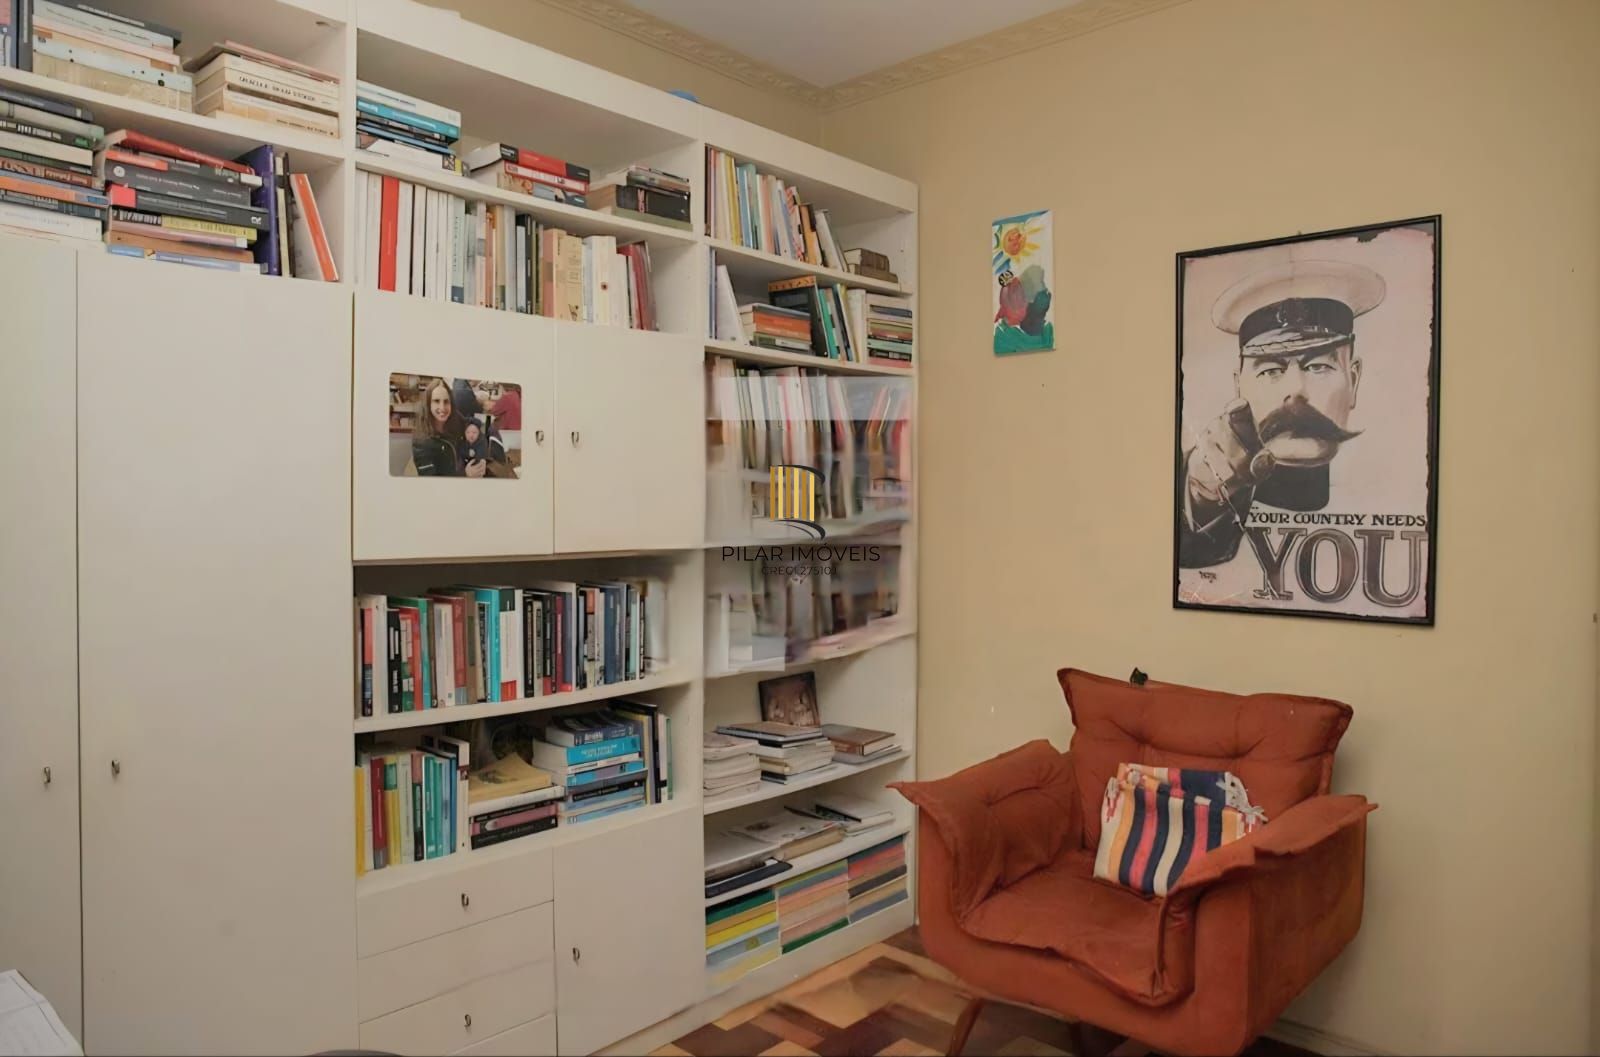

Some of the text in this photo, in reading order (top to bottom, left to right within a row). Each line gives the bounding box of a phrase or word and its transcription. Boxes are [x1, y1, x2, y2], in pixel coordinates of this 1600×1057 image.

[1250, 512, 1426, 527] YOUR COUNTRY NEEDS
[1249, 526, 1428, 608] YOU
